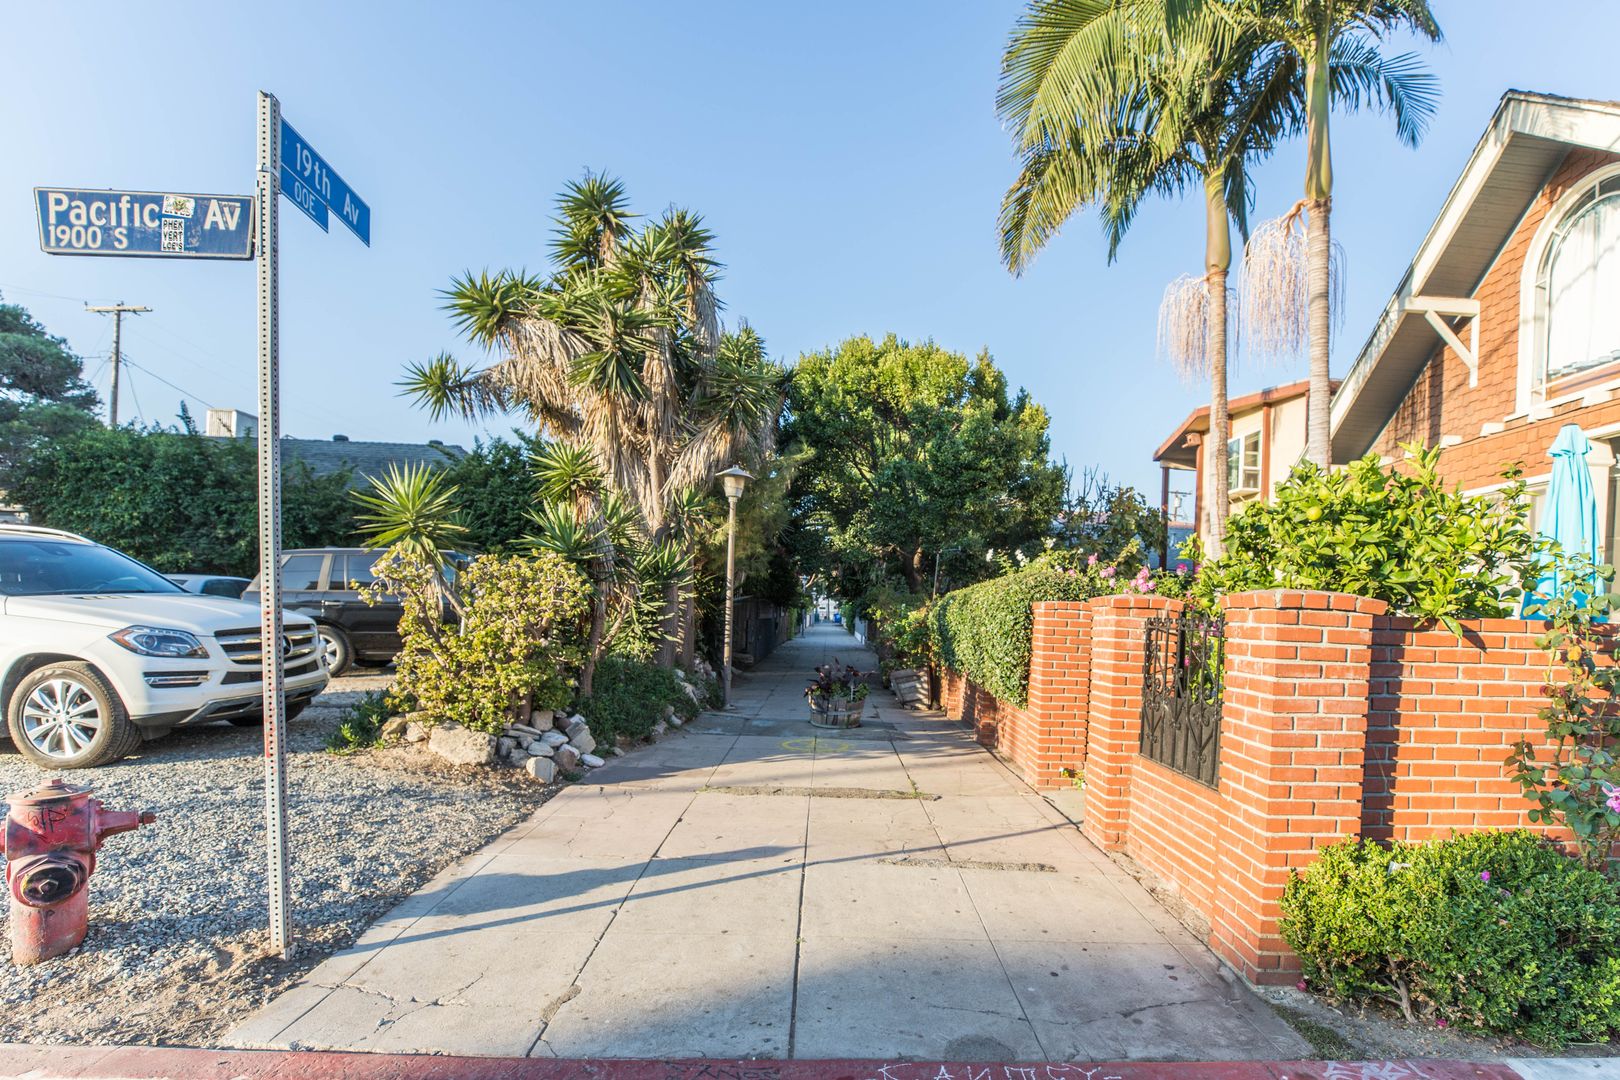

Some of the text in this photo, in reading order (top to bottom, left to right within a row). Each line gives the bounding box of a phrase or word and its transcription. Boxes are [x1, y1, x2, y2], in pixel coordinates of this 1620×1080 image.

[296, 143, 360, 225] 19th Av
[48, 192, 241, 231] Pacific Av
[47, 223, 128, 250] 1900 S
